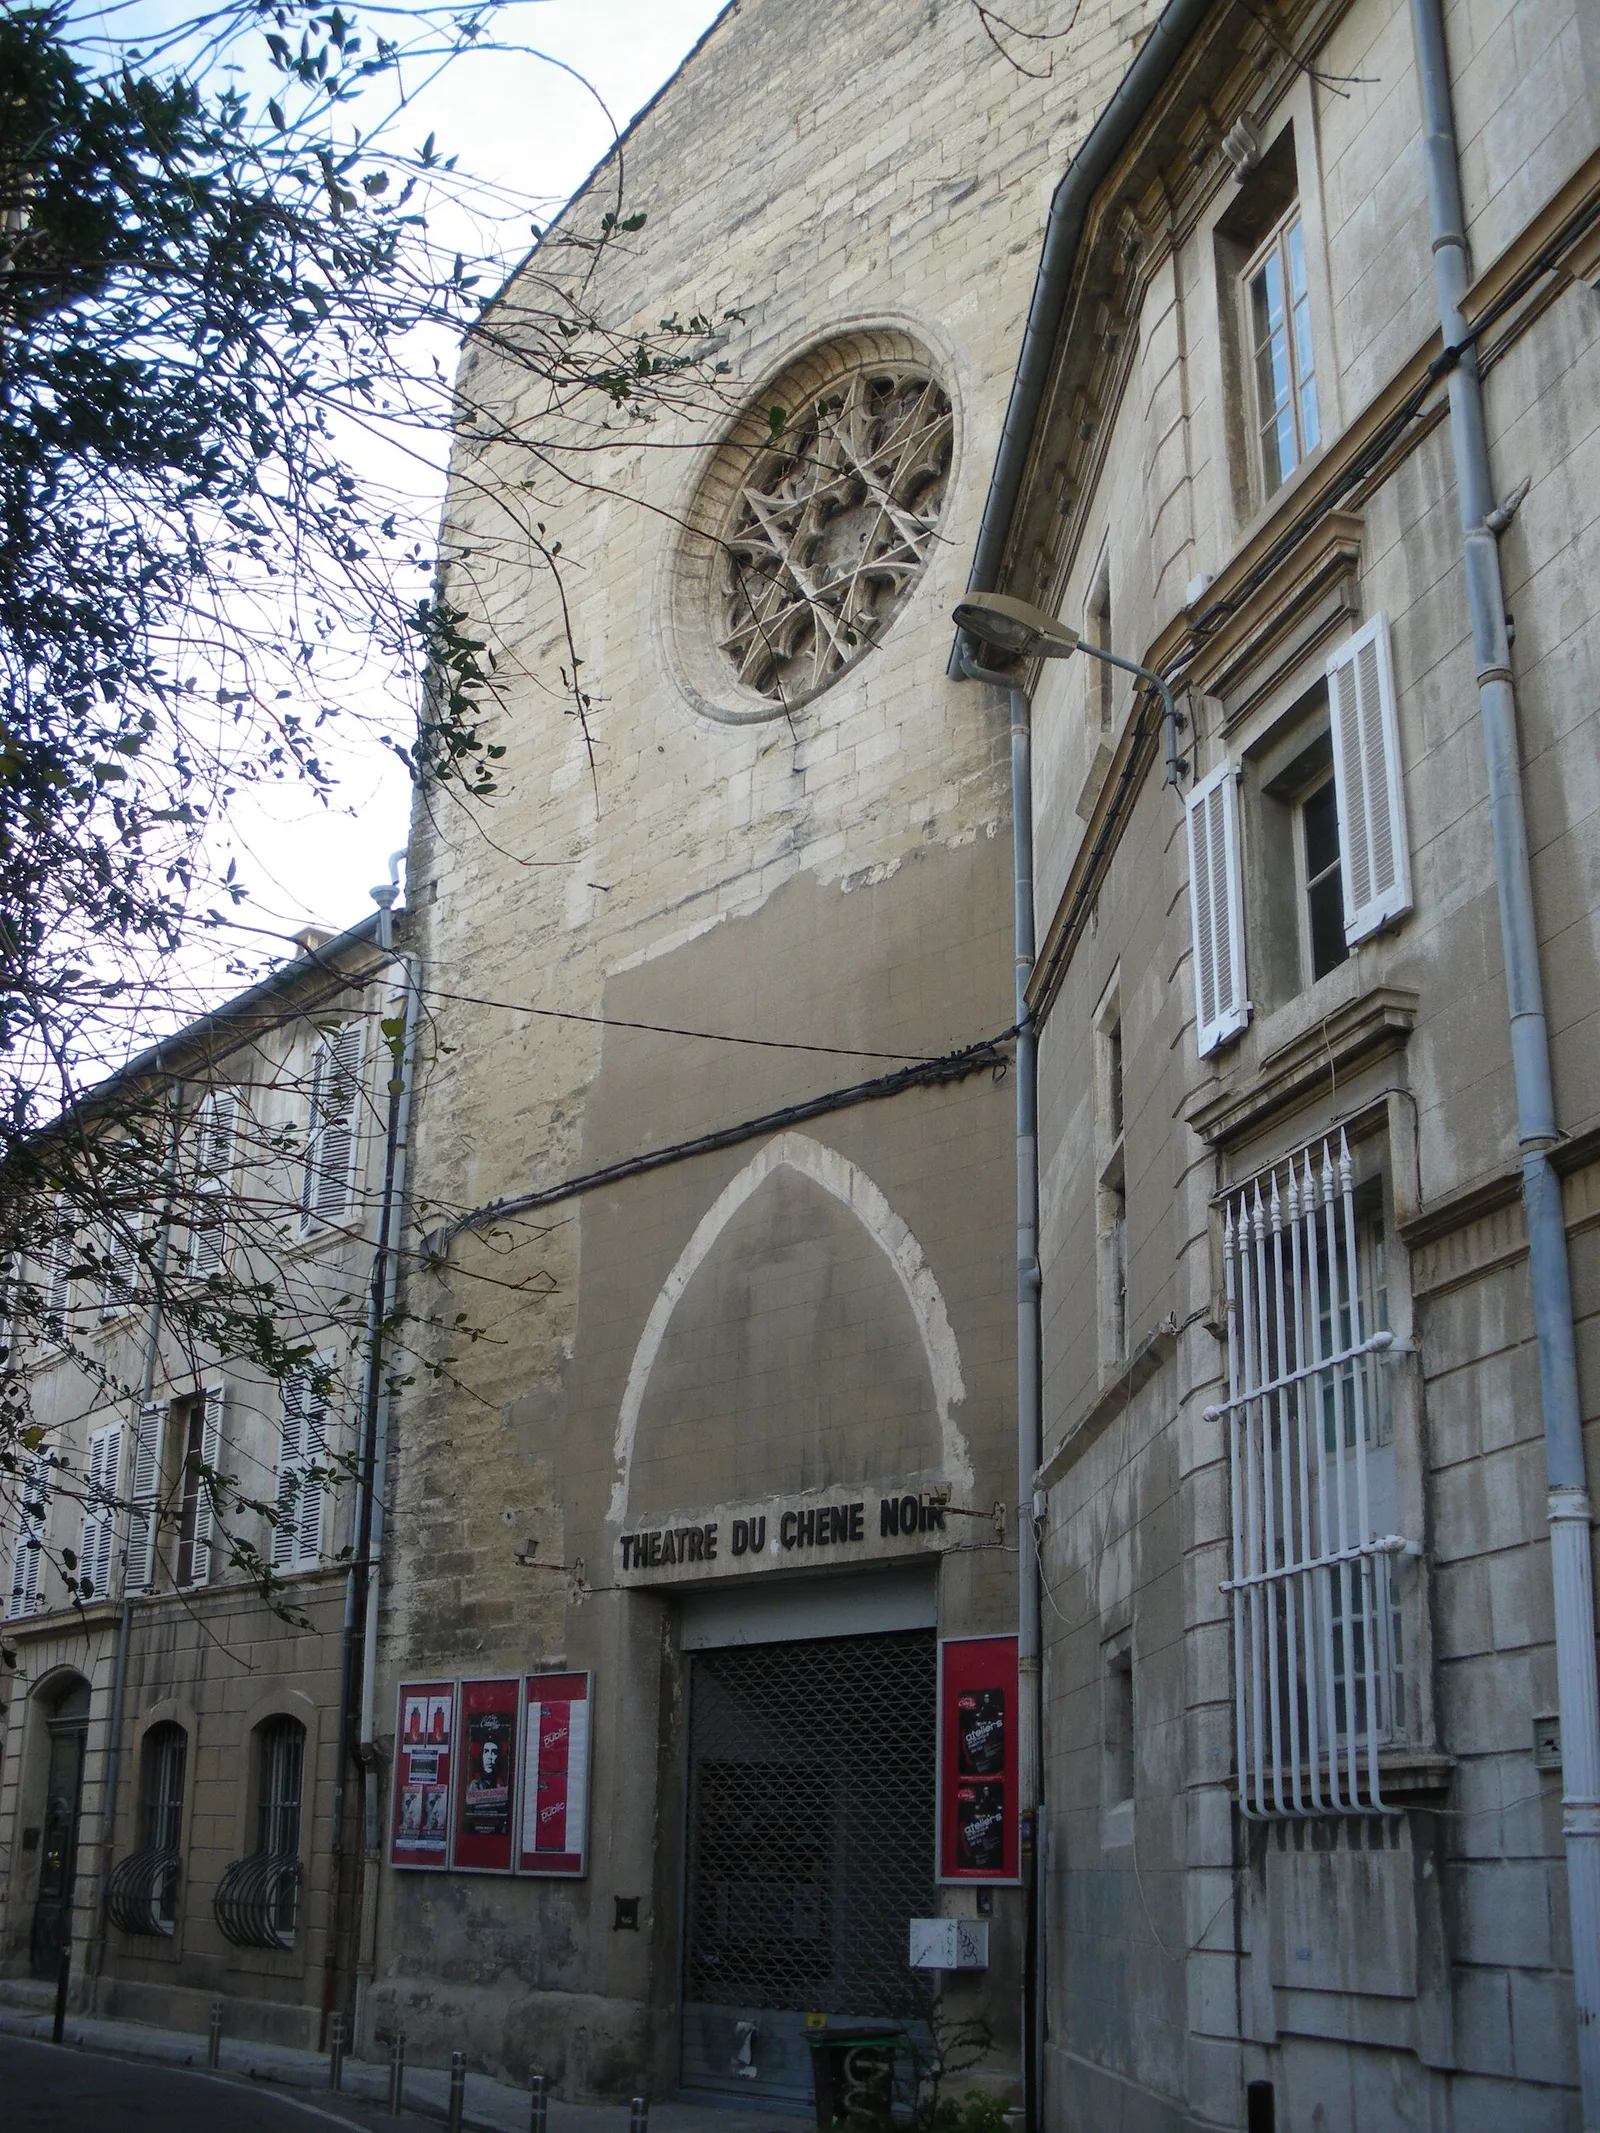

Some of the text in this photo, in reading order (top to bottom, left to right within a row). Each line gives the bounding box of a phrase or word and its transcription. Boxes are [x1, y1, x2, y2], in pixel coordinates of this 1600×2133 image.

[620, 1493, 946, 1570] THEATRE DU CHENE NOIR
[543, 1727, 568, 1748] public
[965, 1719, 1003, 1742] ateliers
[541, 1802, 565, 1823] public
[964, 1812, 1003, 1834] ateliers
